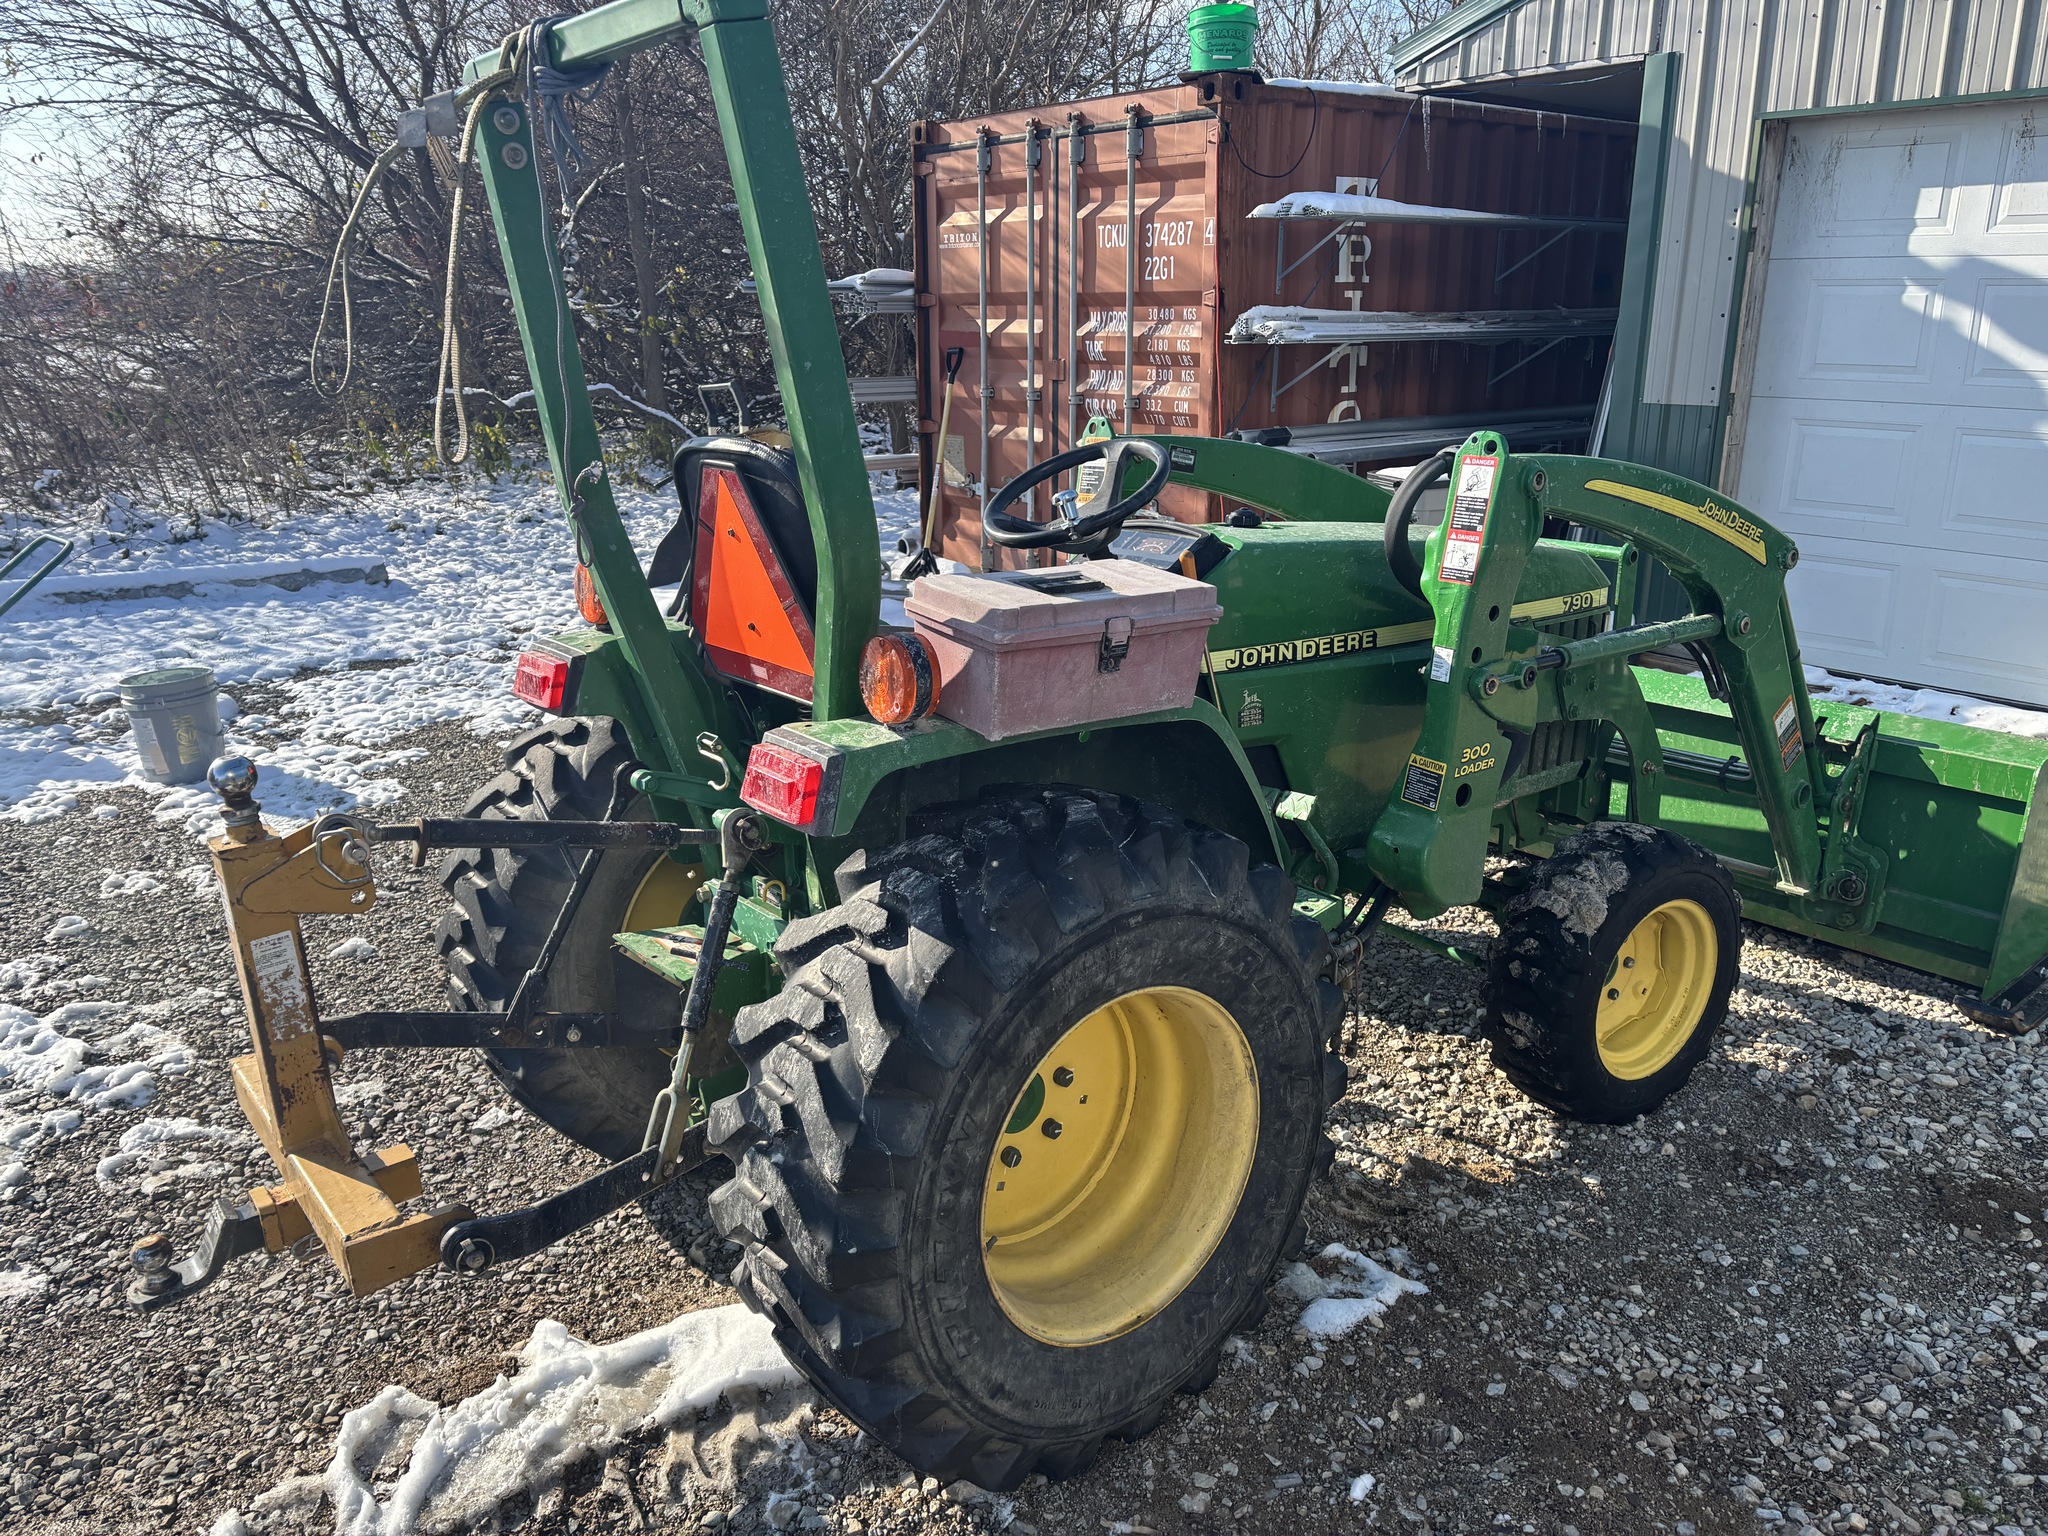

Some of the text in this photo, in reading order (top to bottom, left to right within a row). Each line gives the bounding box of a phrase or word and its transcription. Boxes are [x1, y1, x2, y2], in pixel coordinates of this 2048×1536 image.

[1197, 28, 1249, 42] MENARDS
[943, 232, 978, 243] TRITON
[1098, 218, 1214, 248] TCKU 374287 4
[1144, 255, 1174, 280] 22G1
[1148, 308, 1175, 320] 30.480
[1183, 308, 1197, 320] KGS
[1144, 324, 1194, 335] 67.200 LBS
[1085, 339, 1191, 361] TARE 2.180 KGS
[1149, 354, 1194, 366] 4.810 LBS
[1087, 369, 1195, 391] PAYLOAD 28.300 KGS
[1142, 385, 1192, 397] 62.390 LBS
[1145, 399, 1162, 411] 33.2
[1174, 400, 1189, 413] CUM
[1143, 413, 1192, 427] 1.170 CUFT
[1471, 457, 1495, 467] DANGER
[1698, 497, 1764, 543] JOHN DEERE
[1457, 532, 1480, 543] DANGER
[1563, 592, 1593, 613] 790
[1226, 630, 1378, 669] JOHN DEERE
[1461, 742, 1491, 763] 300
[1418, 757, 1445, 773] CAUTION
[1454, 757, 1495, 778] LOADER
